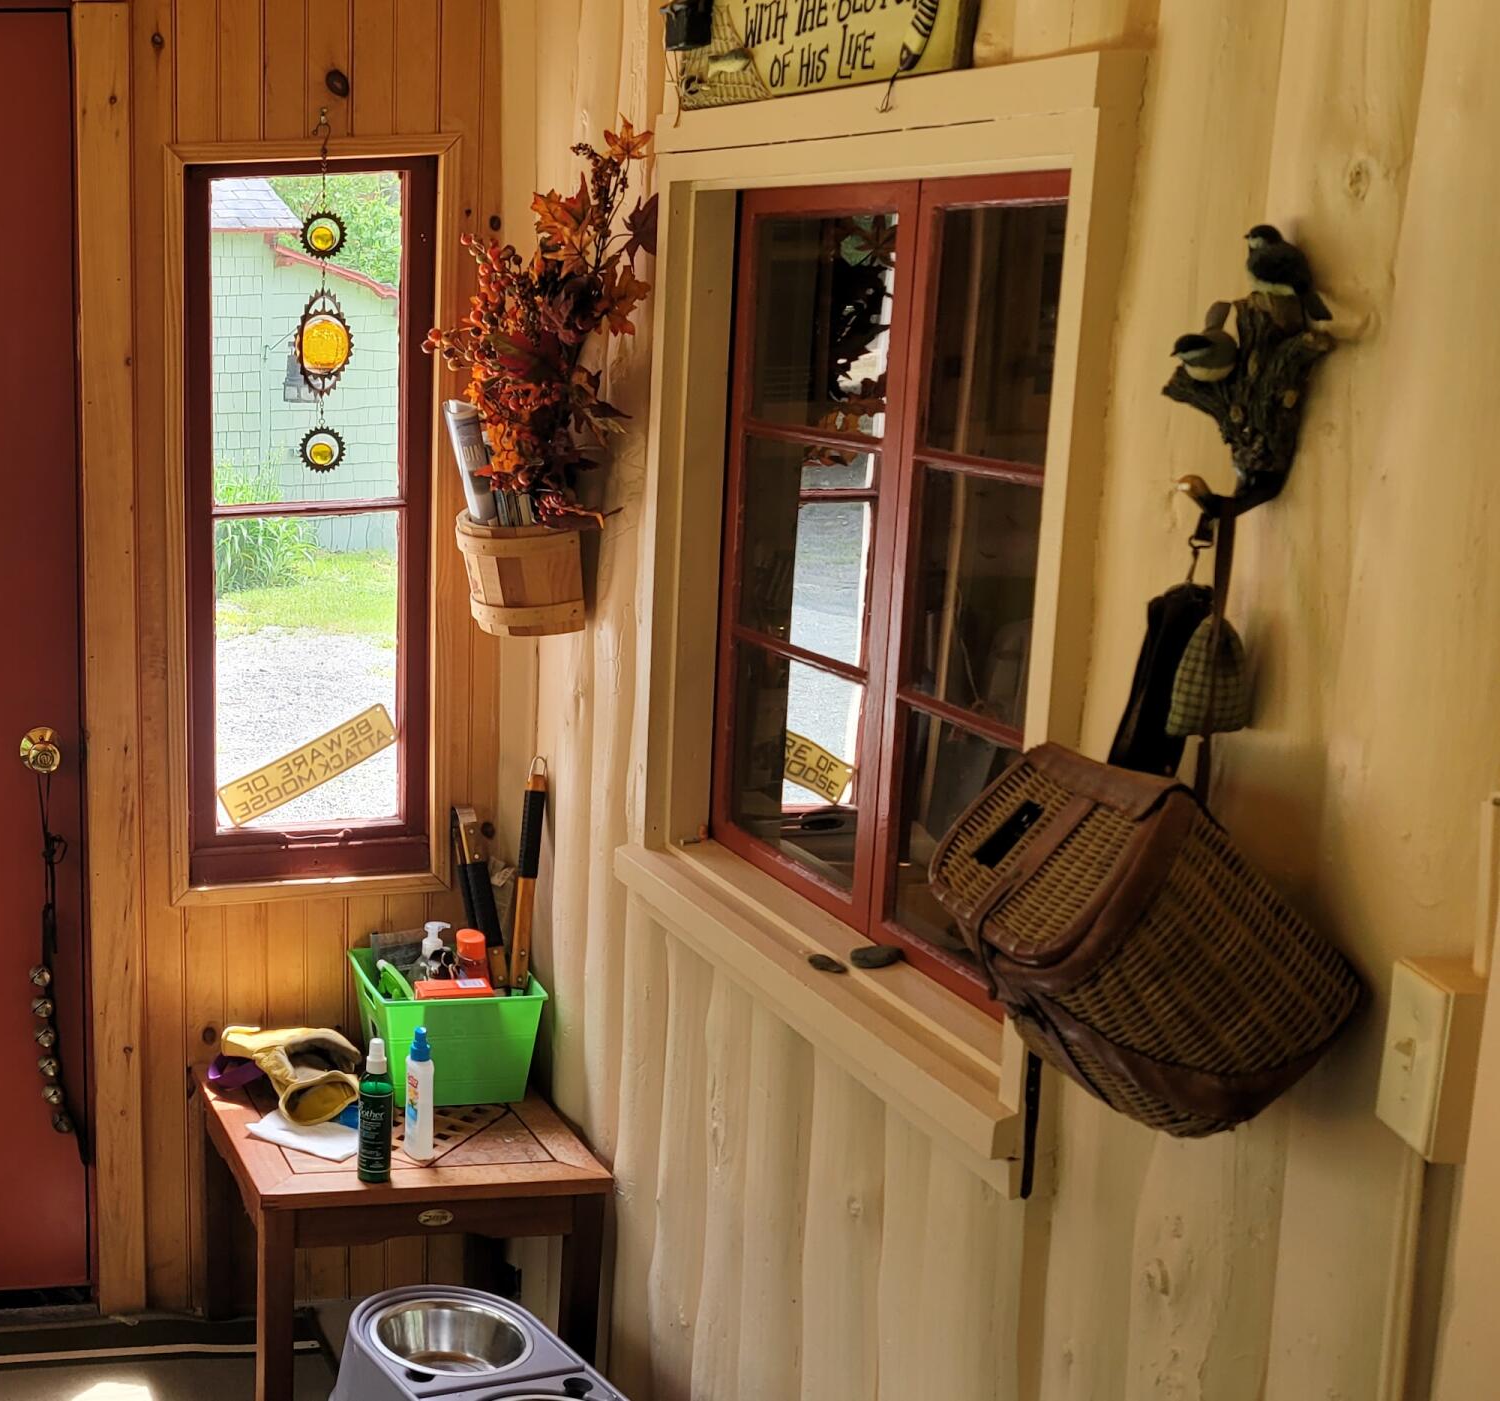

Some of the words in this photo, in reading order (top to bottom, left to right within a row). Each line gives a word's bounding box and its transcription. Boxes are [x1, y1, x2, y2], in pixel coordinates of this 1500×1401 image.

[744, 0, 788, 48] WITH
[795, 0, 828, 36] THE
[769, 45, 795, 88] OF
[797, 43, 829, 87] HIS
[837, 24, 876, 79] LIFE
[817, 755, 838, 775] OF
